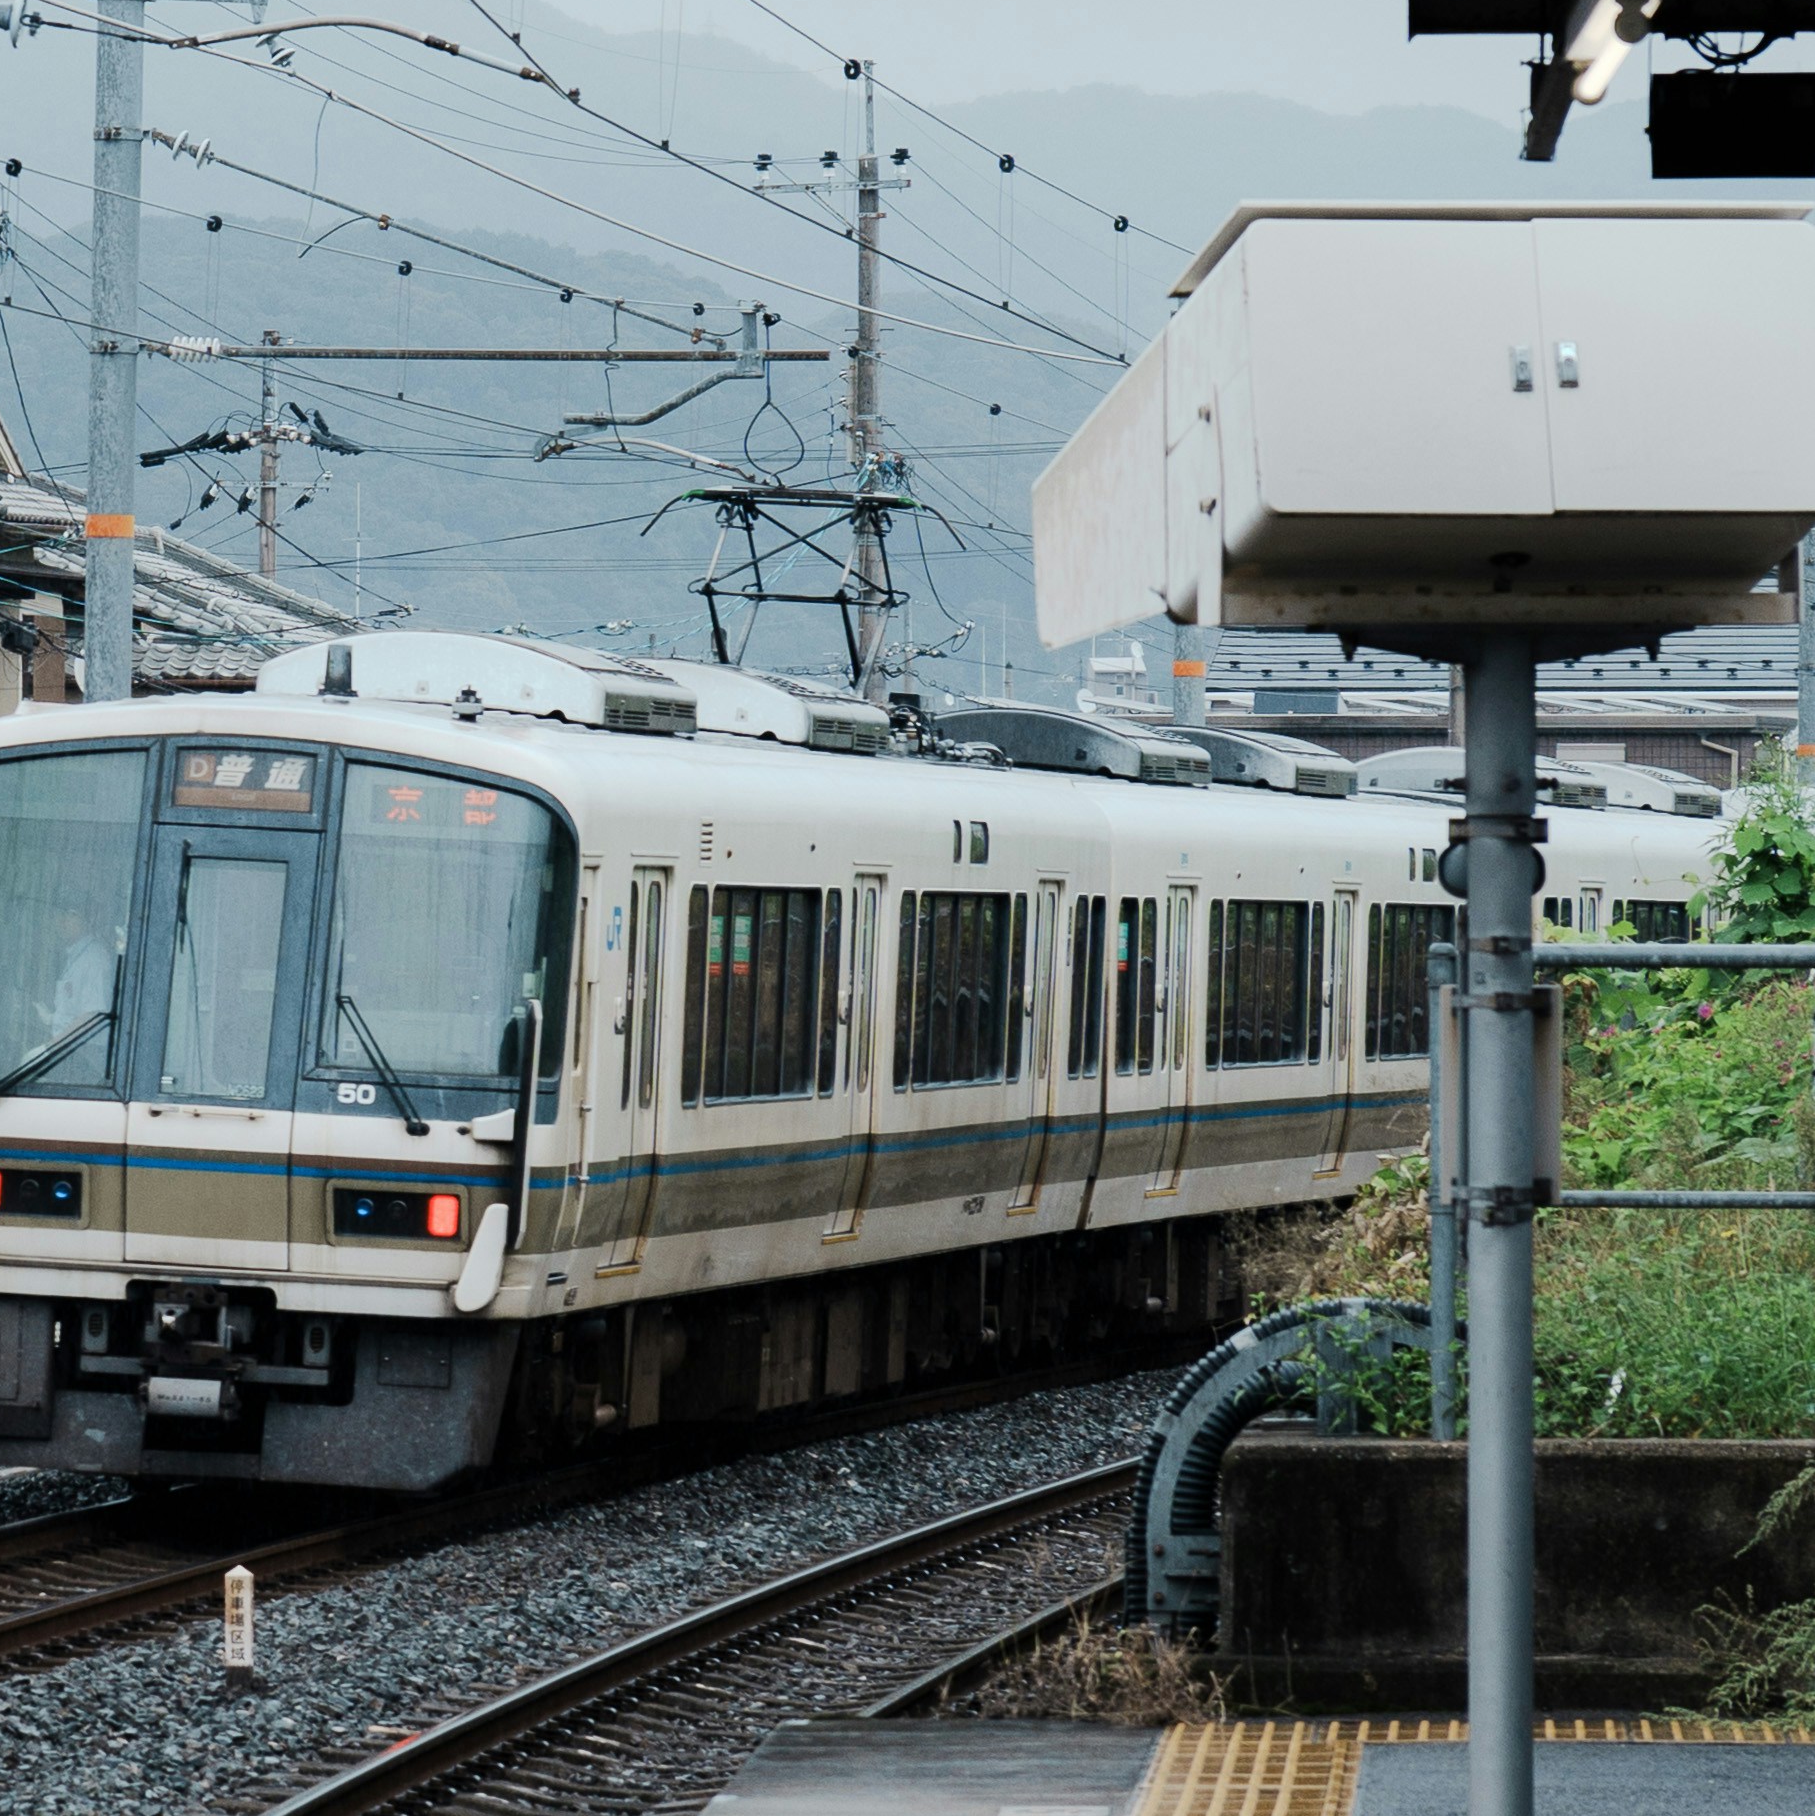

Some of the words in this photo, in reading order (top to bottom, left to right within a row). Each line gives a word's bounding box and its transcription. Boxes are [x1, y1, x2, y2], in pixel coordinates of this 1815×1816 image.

[188, 757, 210, 780] D
[212, 754, 309, 791] 普通
[606, 906, 622, 951] JR
[336, 1083, 376, 1105] 50
[230, 1579, 245, 1661] 停車場区域
